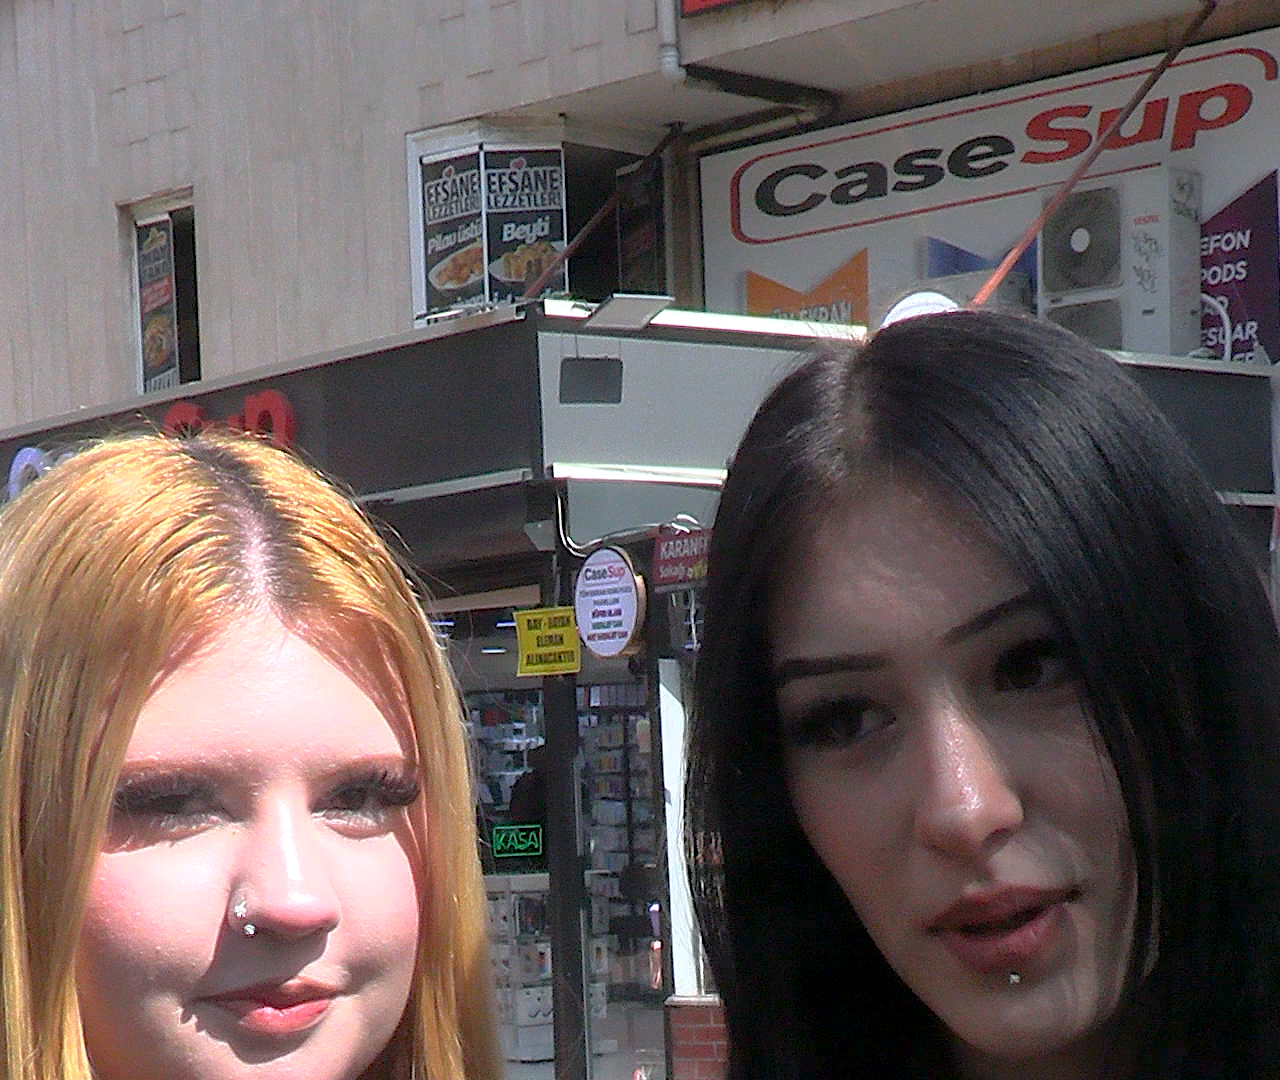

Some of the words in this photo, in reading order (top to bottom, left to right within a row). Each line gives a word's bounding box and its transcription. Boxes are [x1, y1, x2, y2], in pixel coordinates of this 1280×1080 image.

[753, 80, 1254, 219] CaseSup
[426, 172, 479, 204] EFSANE
[486, 169, 560, 193] EFSANE
[501, 216, 551, 244] Beyti
[1201, 230, 1251, 256] EFON
[584, 565, 626, 581] CaseSup
[496, 830, 539, 850] KASA
